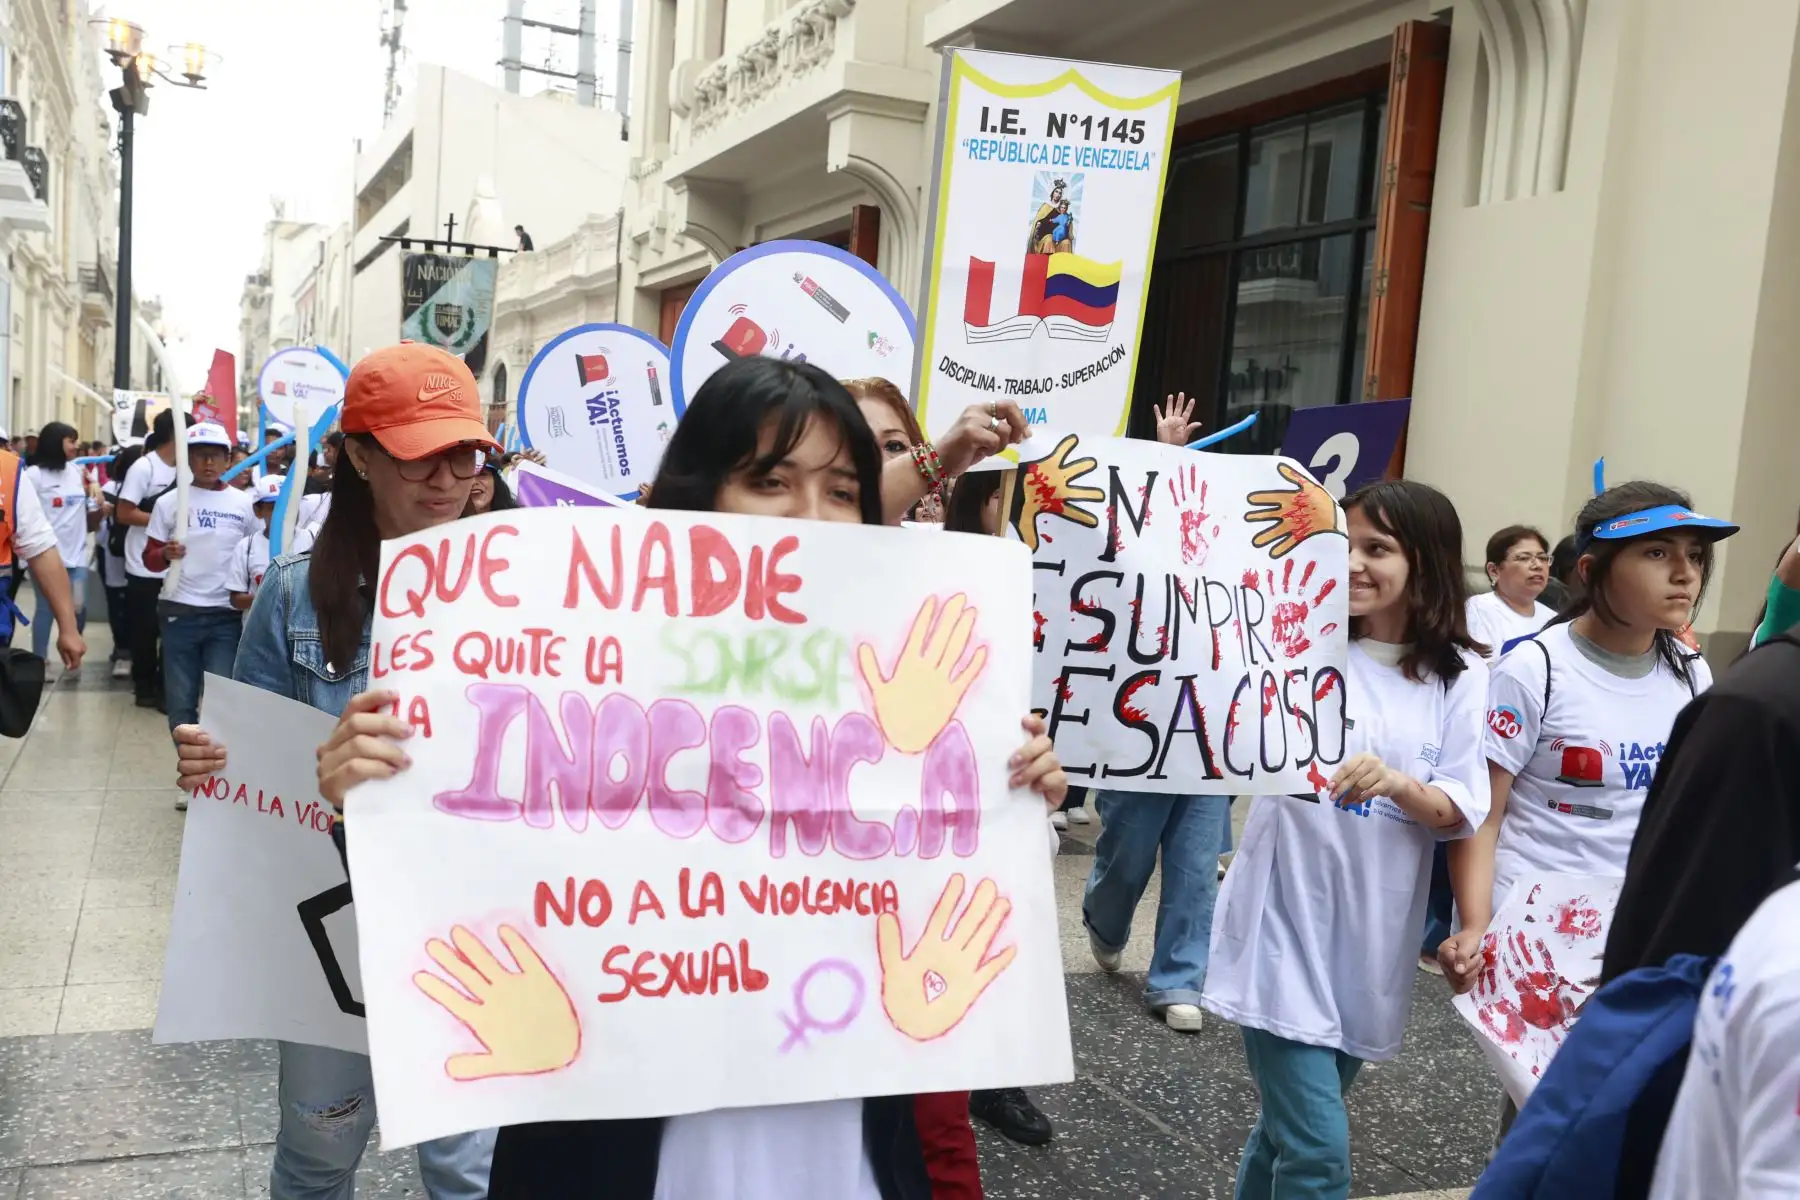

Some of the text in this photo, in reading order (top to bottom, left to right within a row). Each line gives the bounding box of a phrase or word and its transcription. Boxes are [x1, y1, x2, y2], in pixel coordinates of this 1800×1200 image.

[979, 106, 1146, 145] I.E. N°1145
[1052, 144, 1072, 166] DE
[426, 375, 456, 388] NIKE
[938, 354, 996, 393] DISCIPLINA
[1003, 377, 1054, 395] TRABAJO
[1061, 343, 1126, 389] SUPERACIÓN
[585, 391, 610, 426] YA!
[605, 389, 631, 477] ¡Actuemos
[197, 516, 217, 529] YA!
[379, 519, 808, 625] QUE NADIE
[372, 629, 435, 679] LES
[453, 627, 567, 679] QUITE
[584, 635, 624, 685] LA
[1146, 665, 1347, 780] ACOSO
[193, 775, 230, 801] NO
[233, 783, 248, 806] A
[257, 790, 285, 818] LA
[533, 867, 899, 927] NO A LA VIOLENCIA
[597, 938, 770, 1003] SEXUAL
